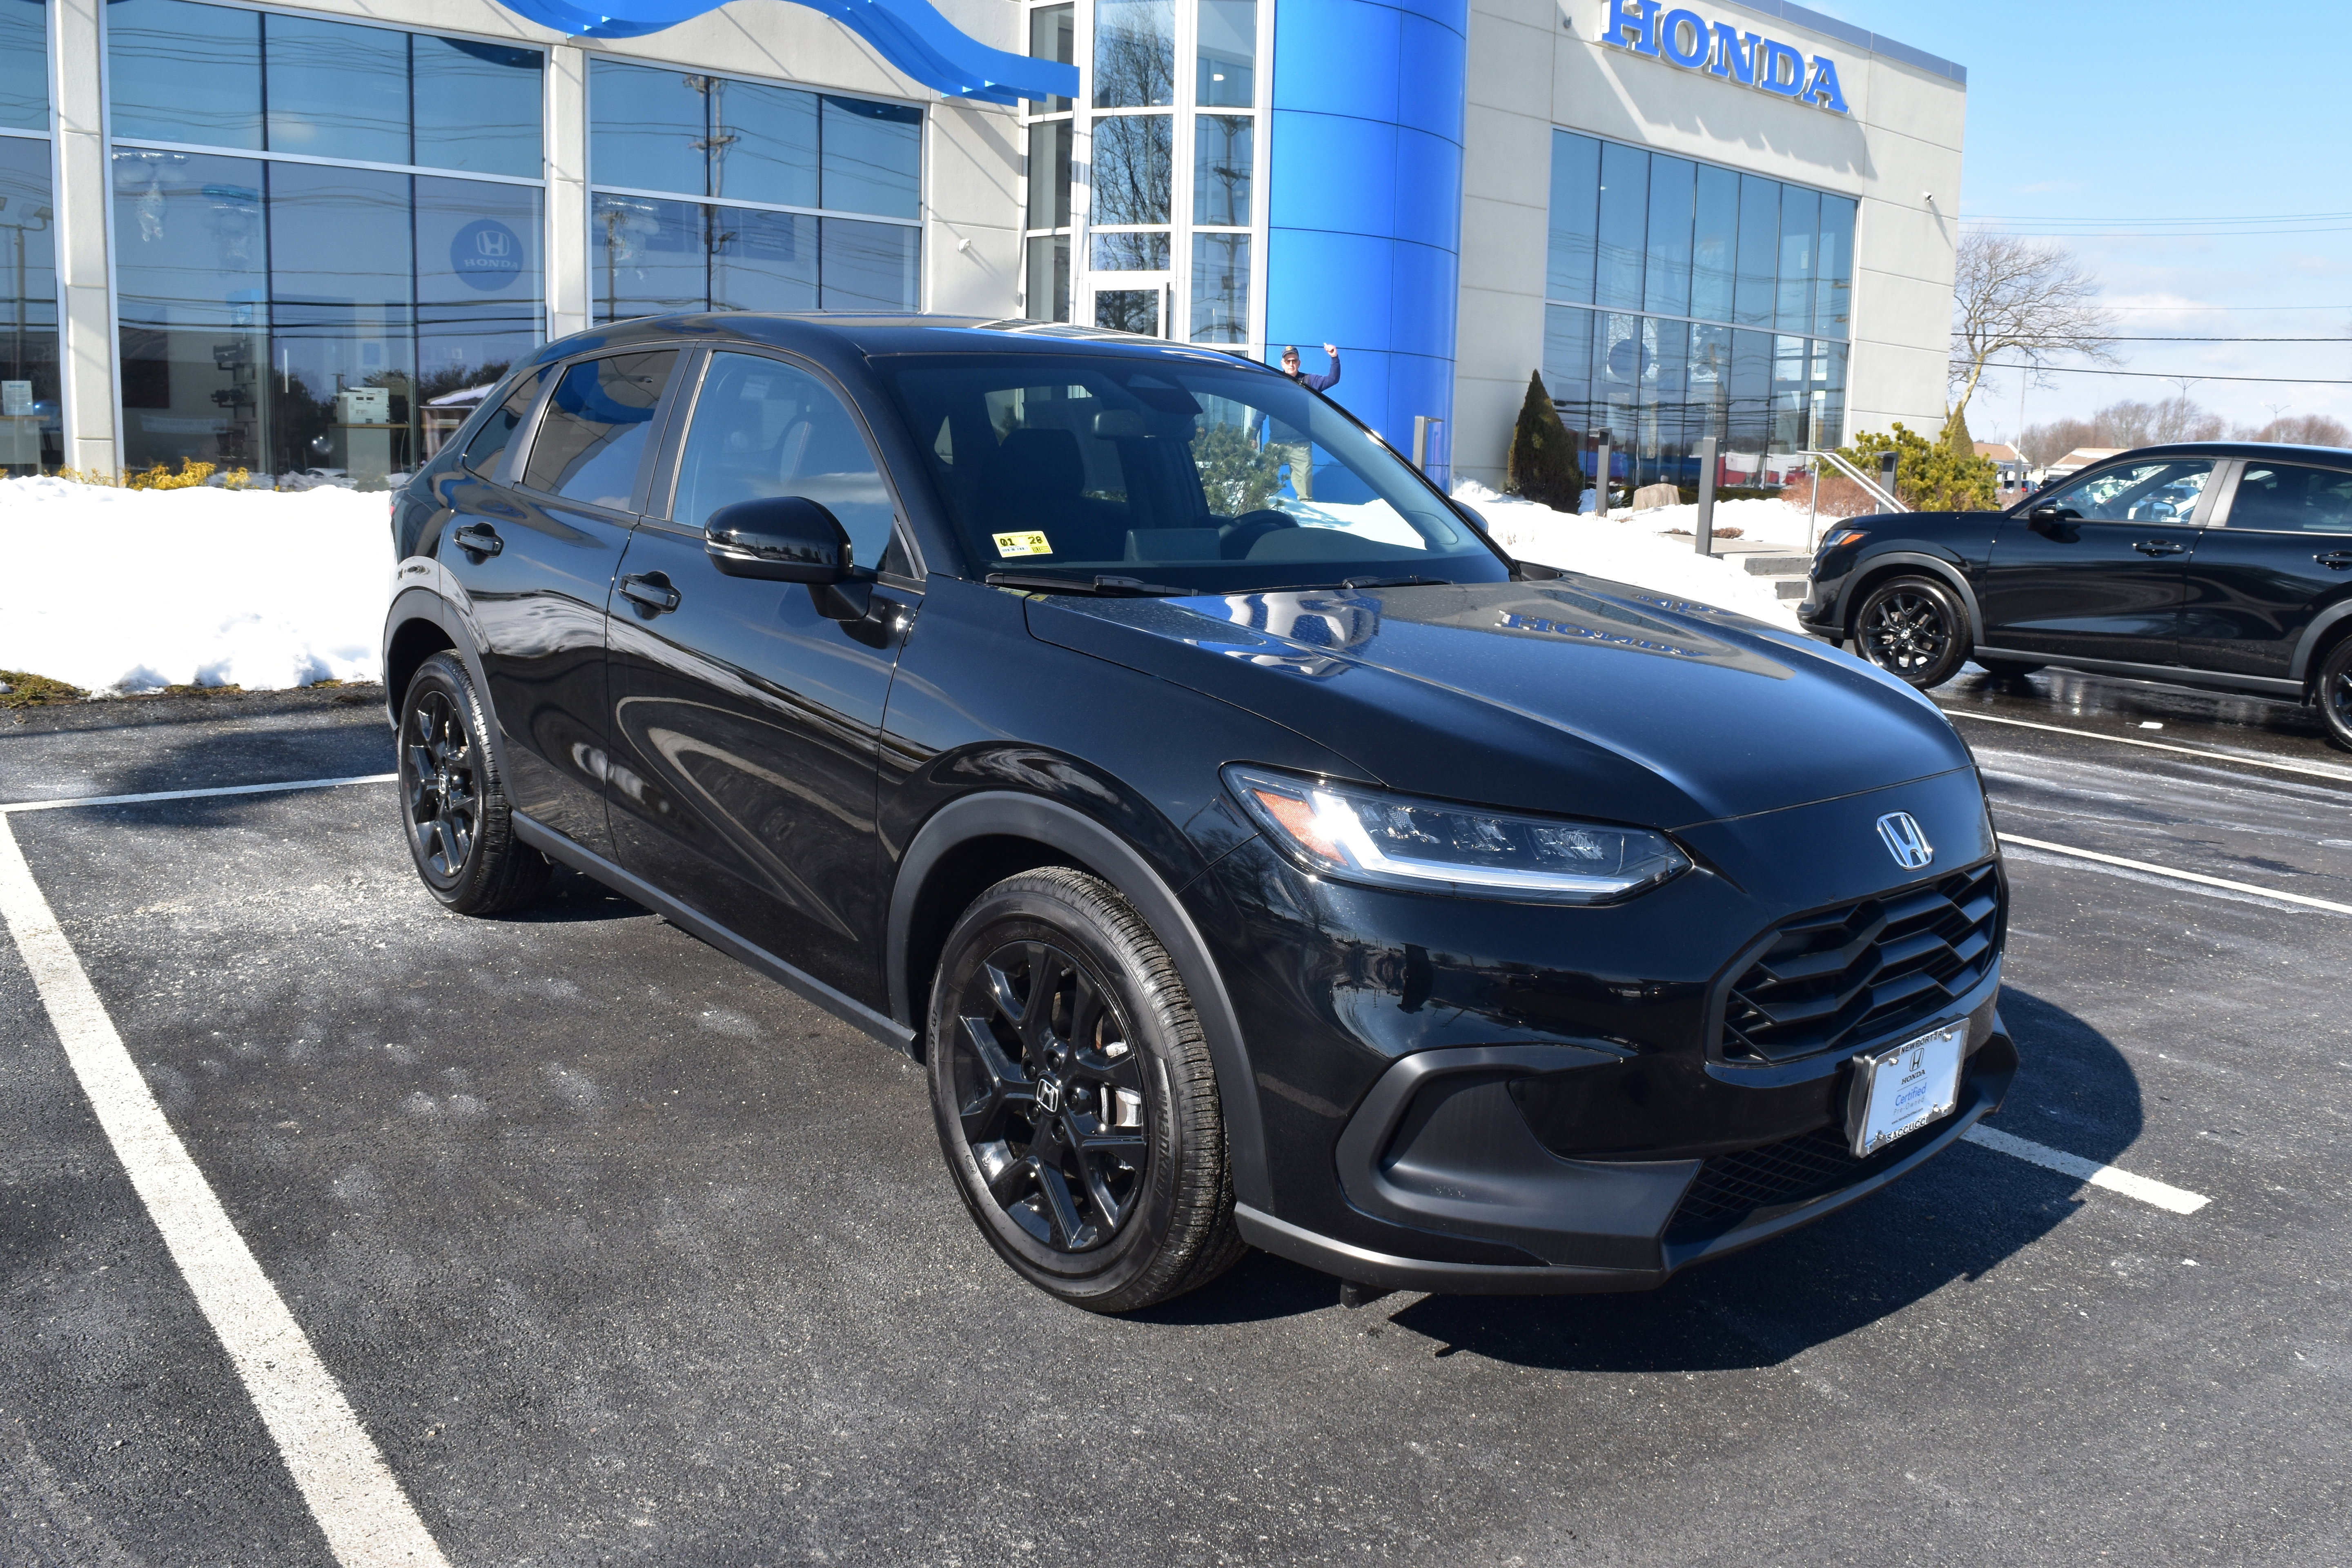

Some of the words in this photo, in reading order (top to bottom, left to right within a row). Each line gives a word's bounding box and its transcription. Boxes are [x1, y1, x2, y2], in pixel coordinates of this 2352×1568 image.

[1597, 0, 1849, 114] HONDA
[464, 258, 518, 270] HONDA
[931, 1006, 938, 1027] GT
[1900, 1032, 1935, 1055] NEWPORT
[1936, 1028, 1946, 1039] RI
[1901, 1069, 1926, 1085] HONDA
[1895, 1082, 1927, 1106] Certified
[1893, 1095, 1925, 1116] Pre-Owned
[1886, 1114, 1929, 1143] SACCUCCI
